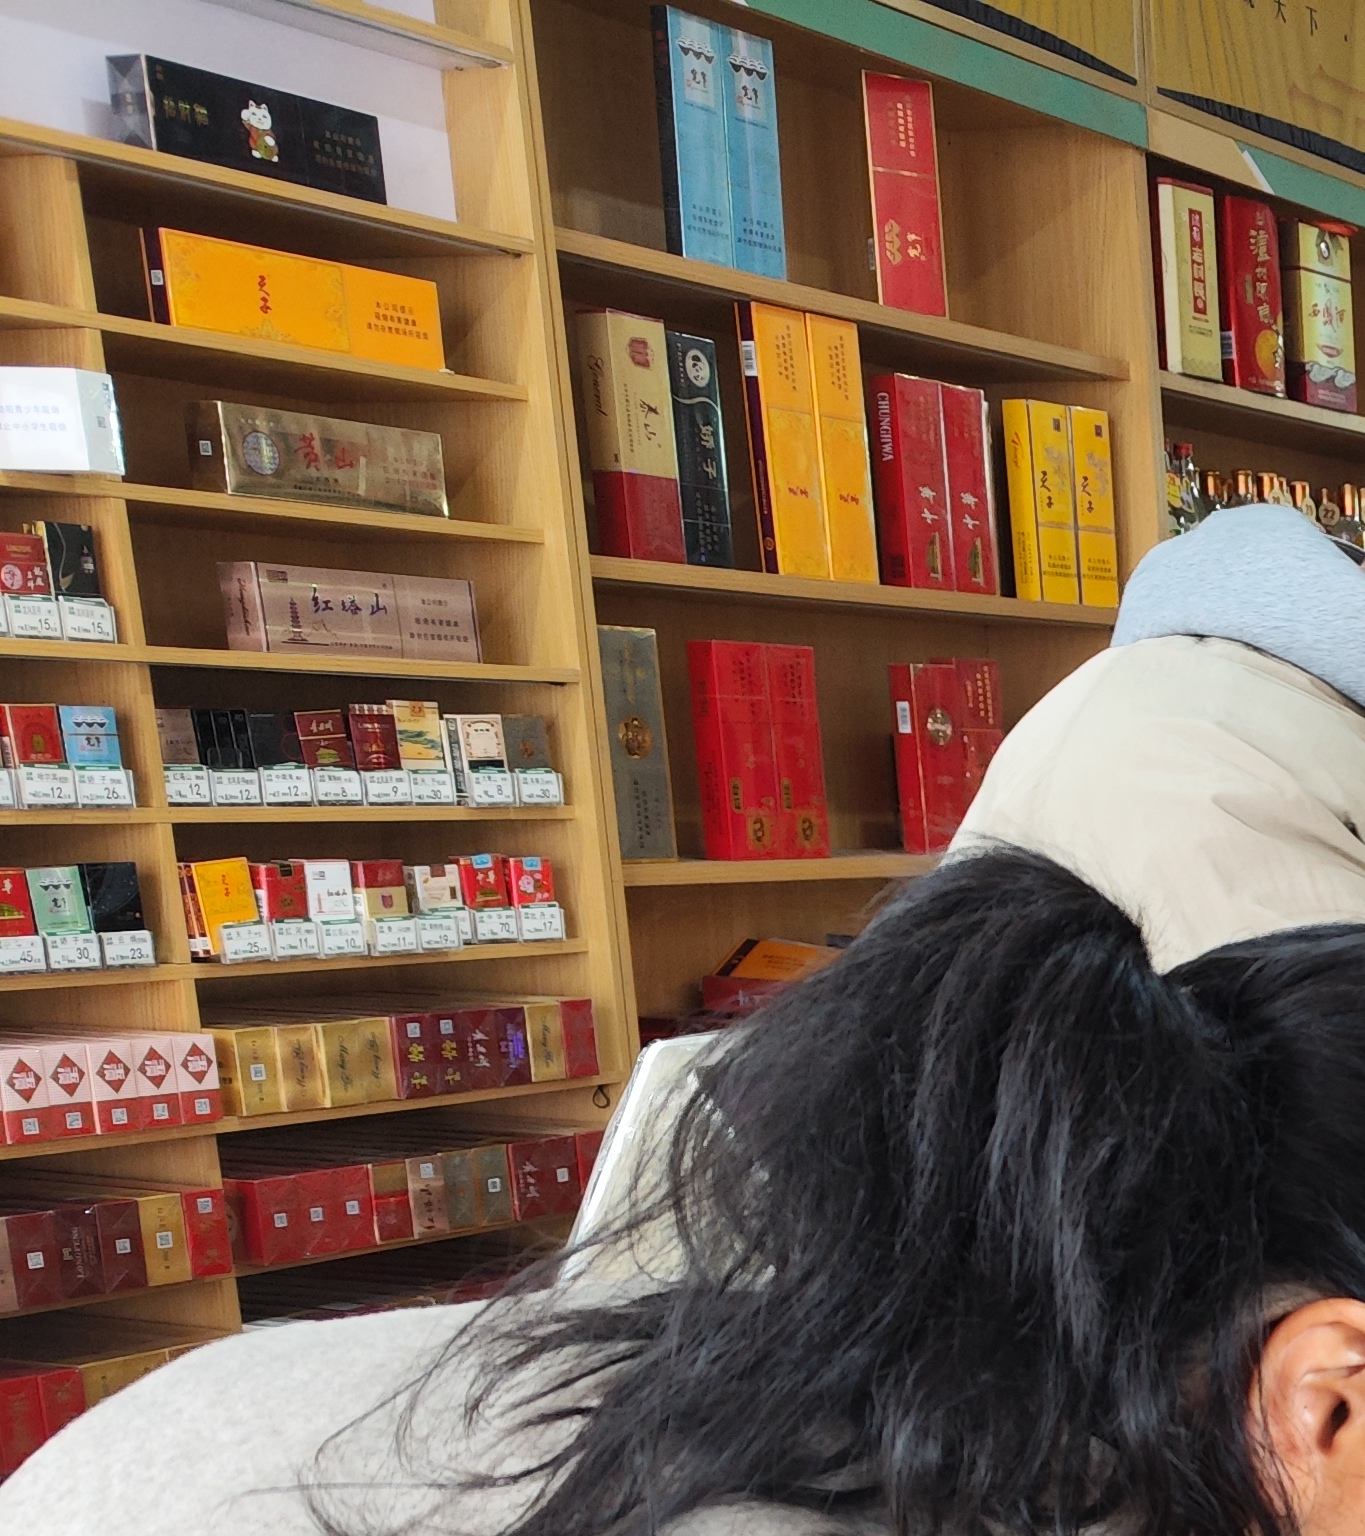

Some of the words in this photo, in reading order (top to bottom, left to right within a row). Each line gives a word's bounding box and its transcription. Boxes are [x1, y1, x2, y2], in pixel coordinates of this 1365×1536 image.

[876, 392, 895, 462] CHUNGHWA
[311, 583, 388, 616] 红塔山
[38, 617, 51, 631] 15
[91, 621, 104, 635] 15
[50, 786, 62, 799] 12
[105, 786, 119, 799] 26
[188, 783, 201, 796] 12
[239, 789, 251, 801] 12
[287, 785, 299, 797] 12
[543, 921, 553, 932] 17
[247, 942, 260, 953] 25
[345, 938, 356, 949] 10
[76, 946, 89, 959] 30
[130, 948, 142, 960] 23
